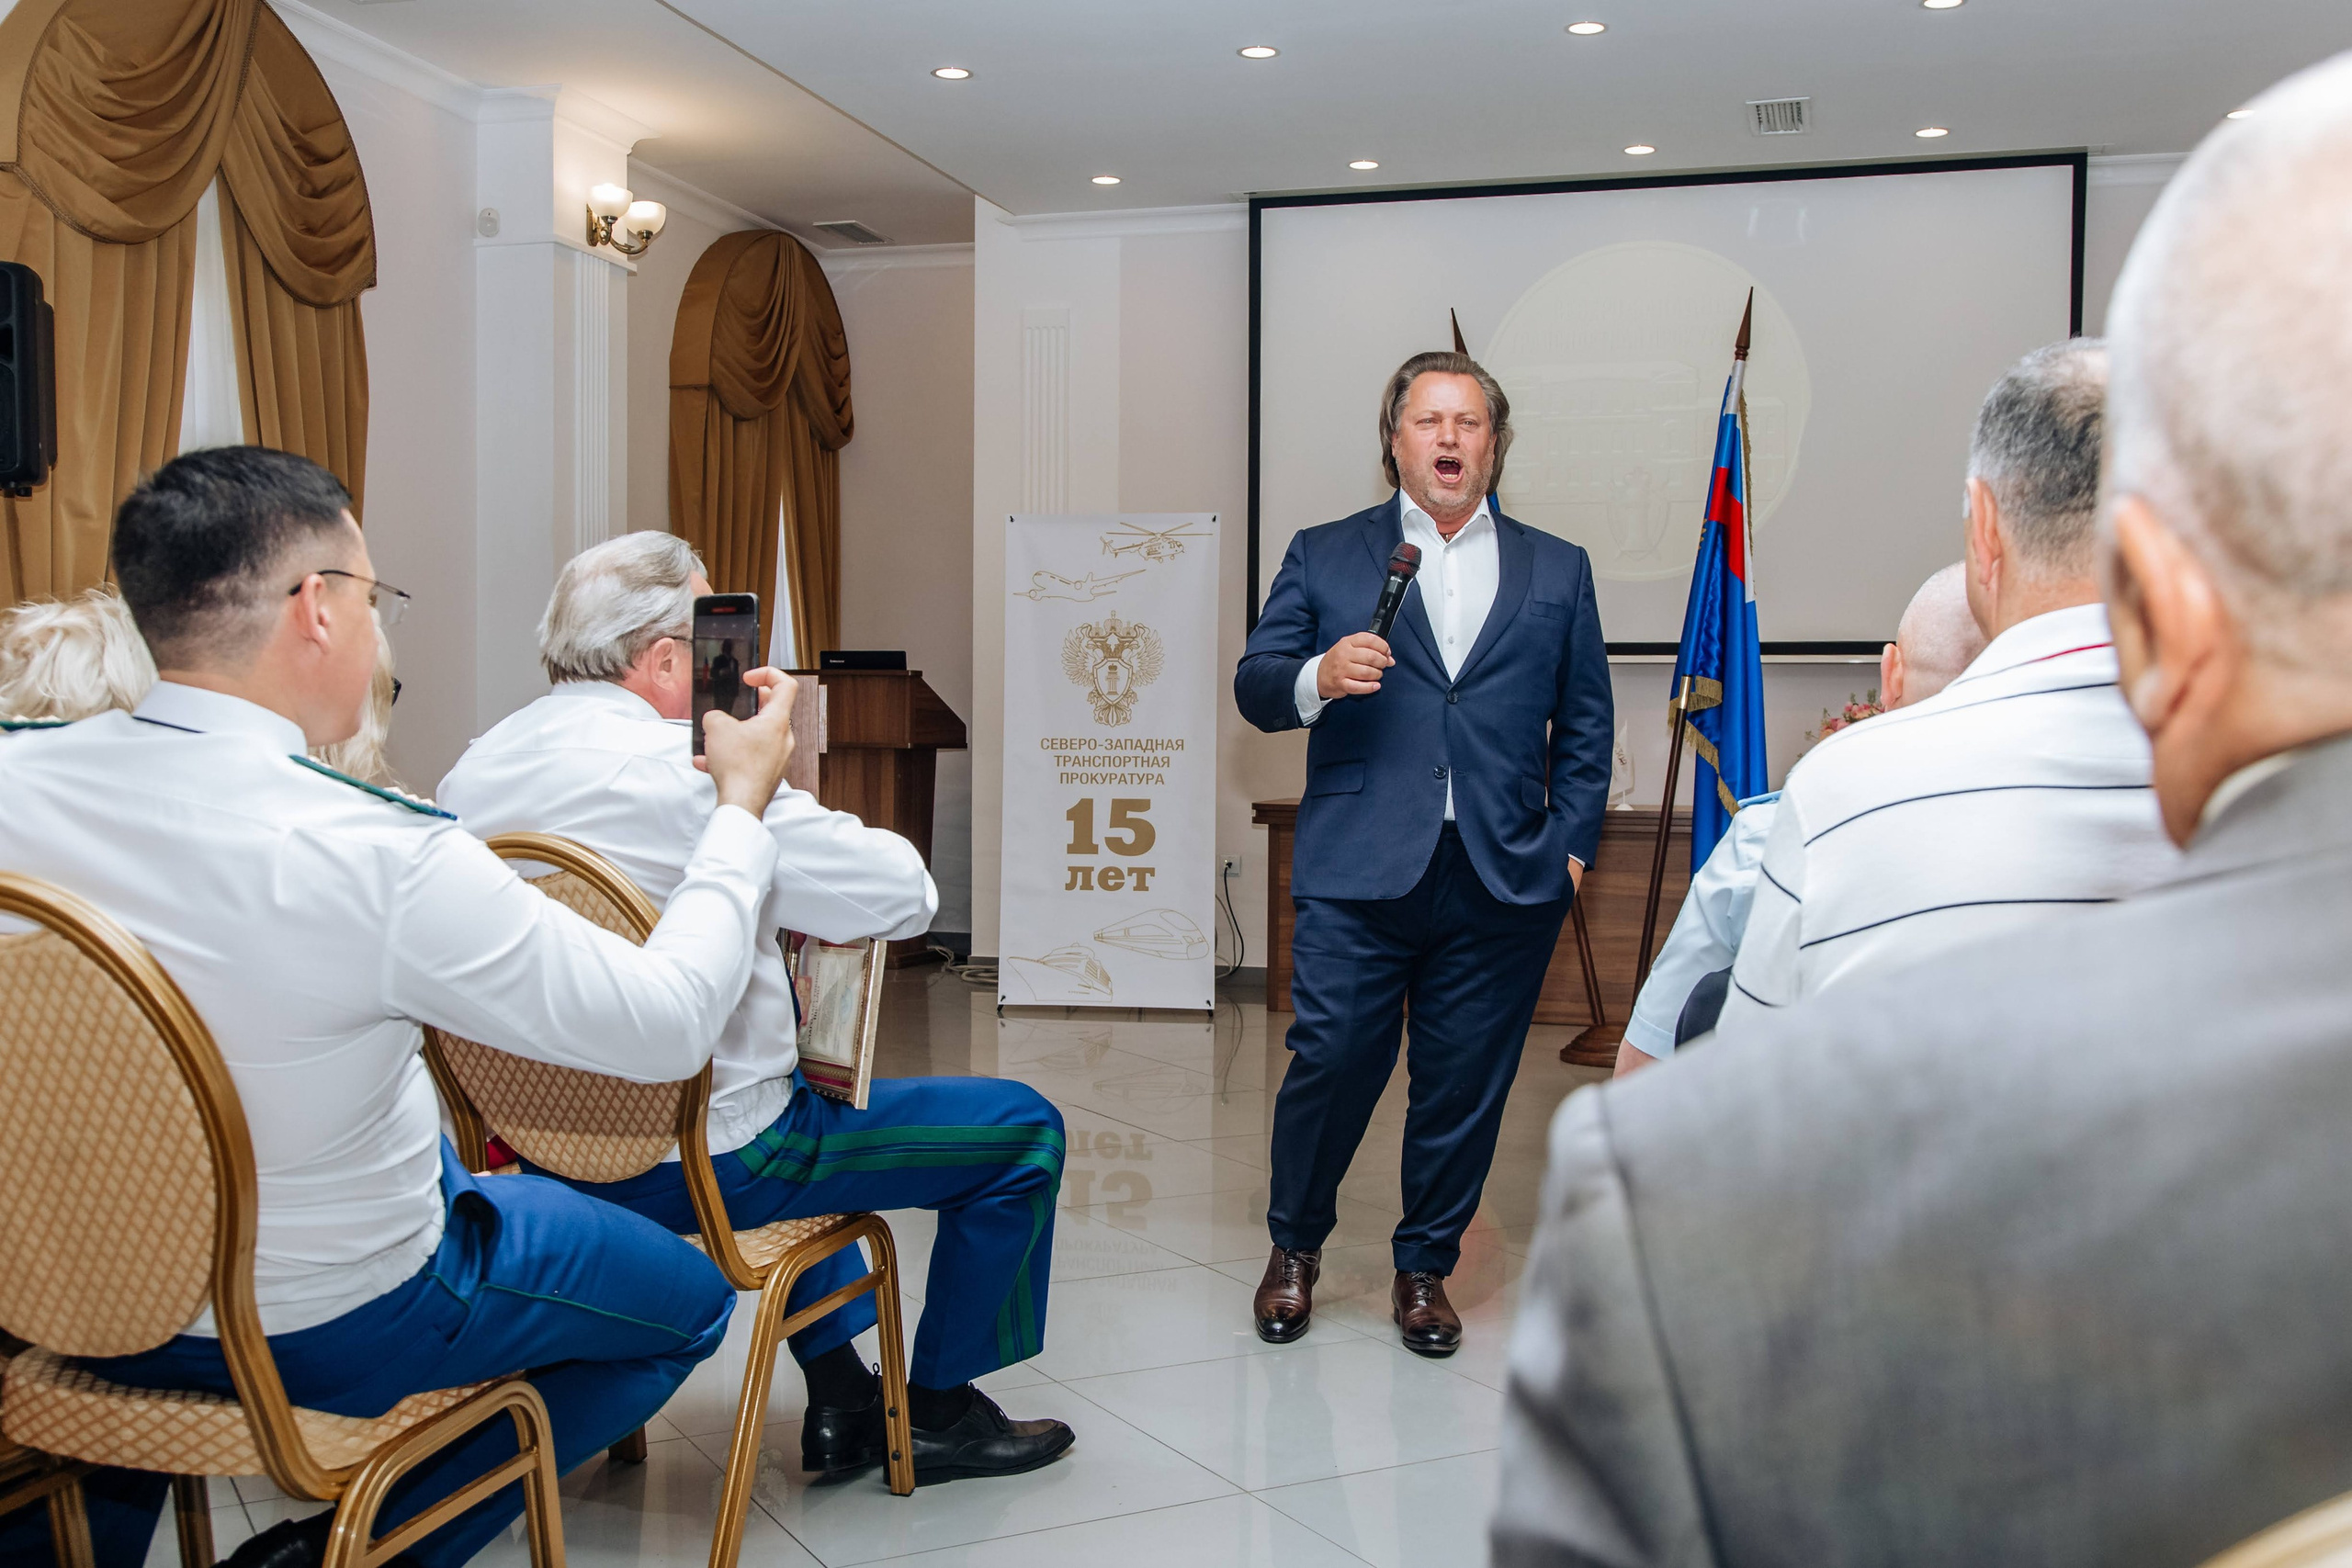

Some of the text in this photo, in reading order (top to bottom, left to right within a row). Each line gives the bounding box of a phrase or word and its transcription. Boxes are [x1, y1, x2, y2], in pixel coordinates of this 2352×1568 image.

[1040, 738, 1184, 752] СЕВЕРО-ЗАПАДНАЯ
[1054, 755, 1170, 768] ТРАНСПОРТНАЯ
[1059, 772, 1165, 785] ПРОКУРАТУРА
[1066, 798, 1156, 856] 15
[1065, 866, 1155, 891] лет
